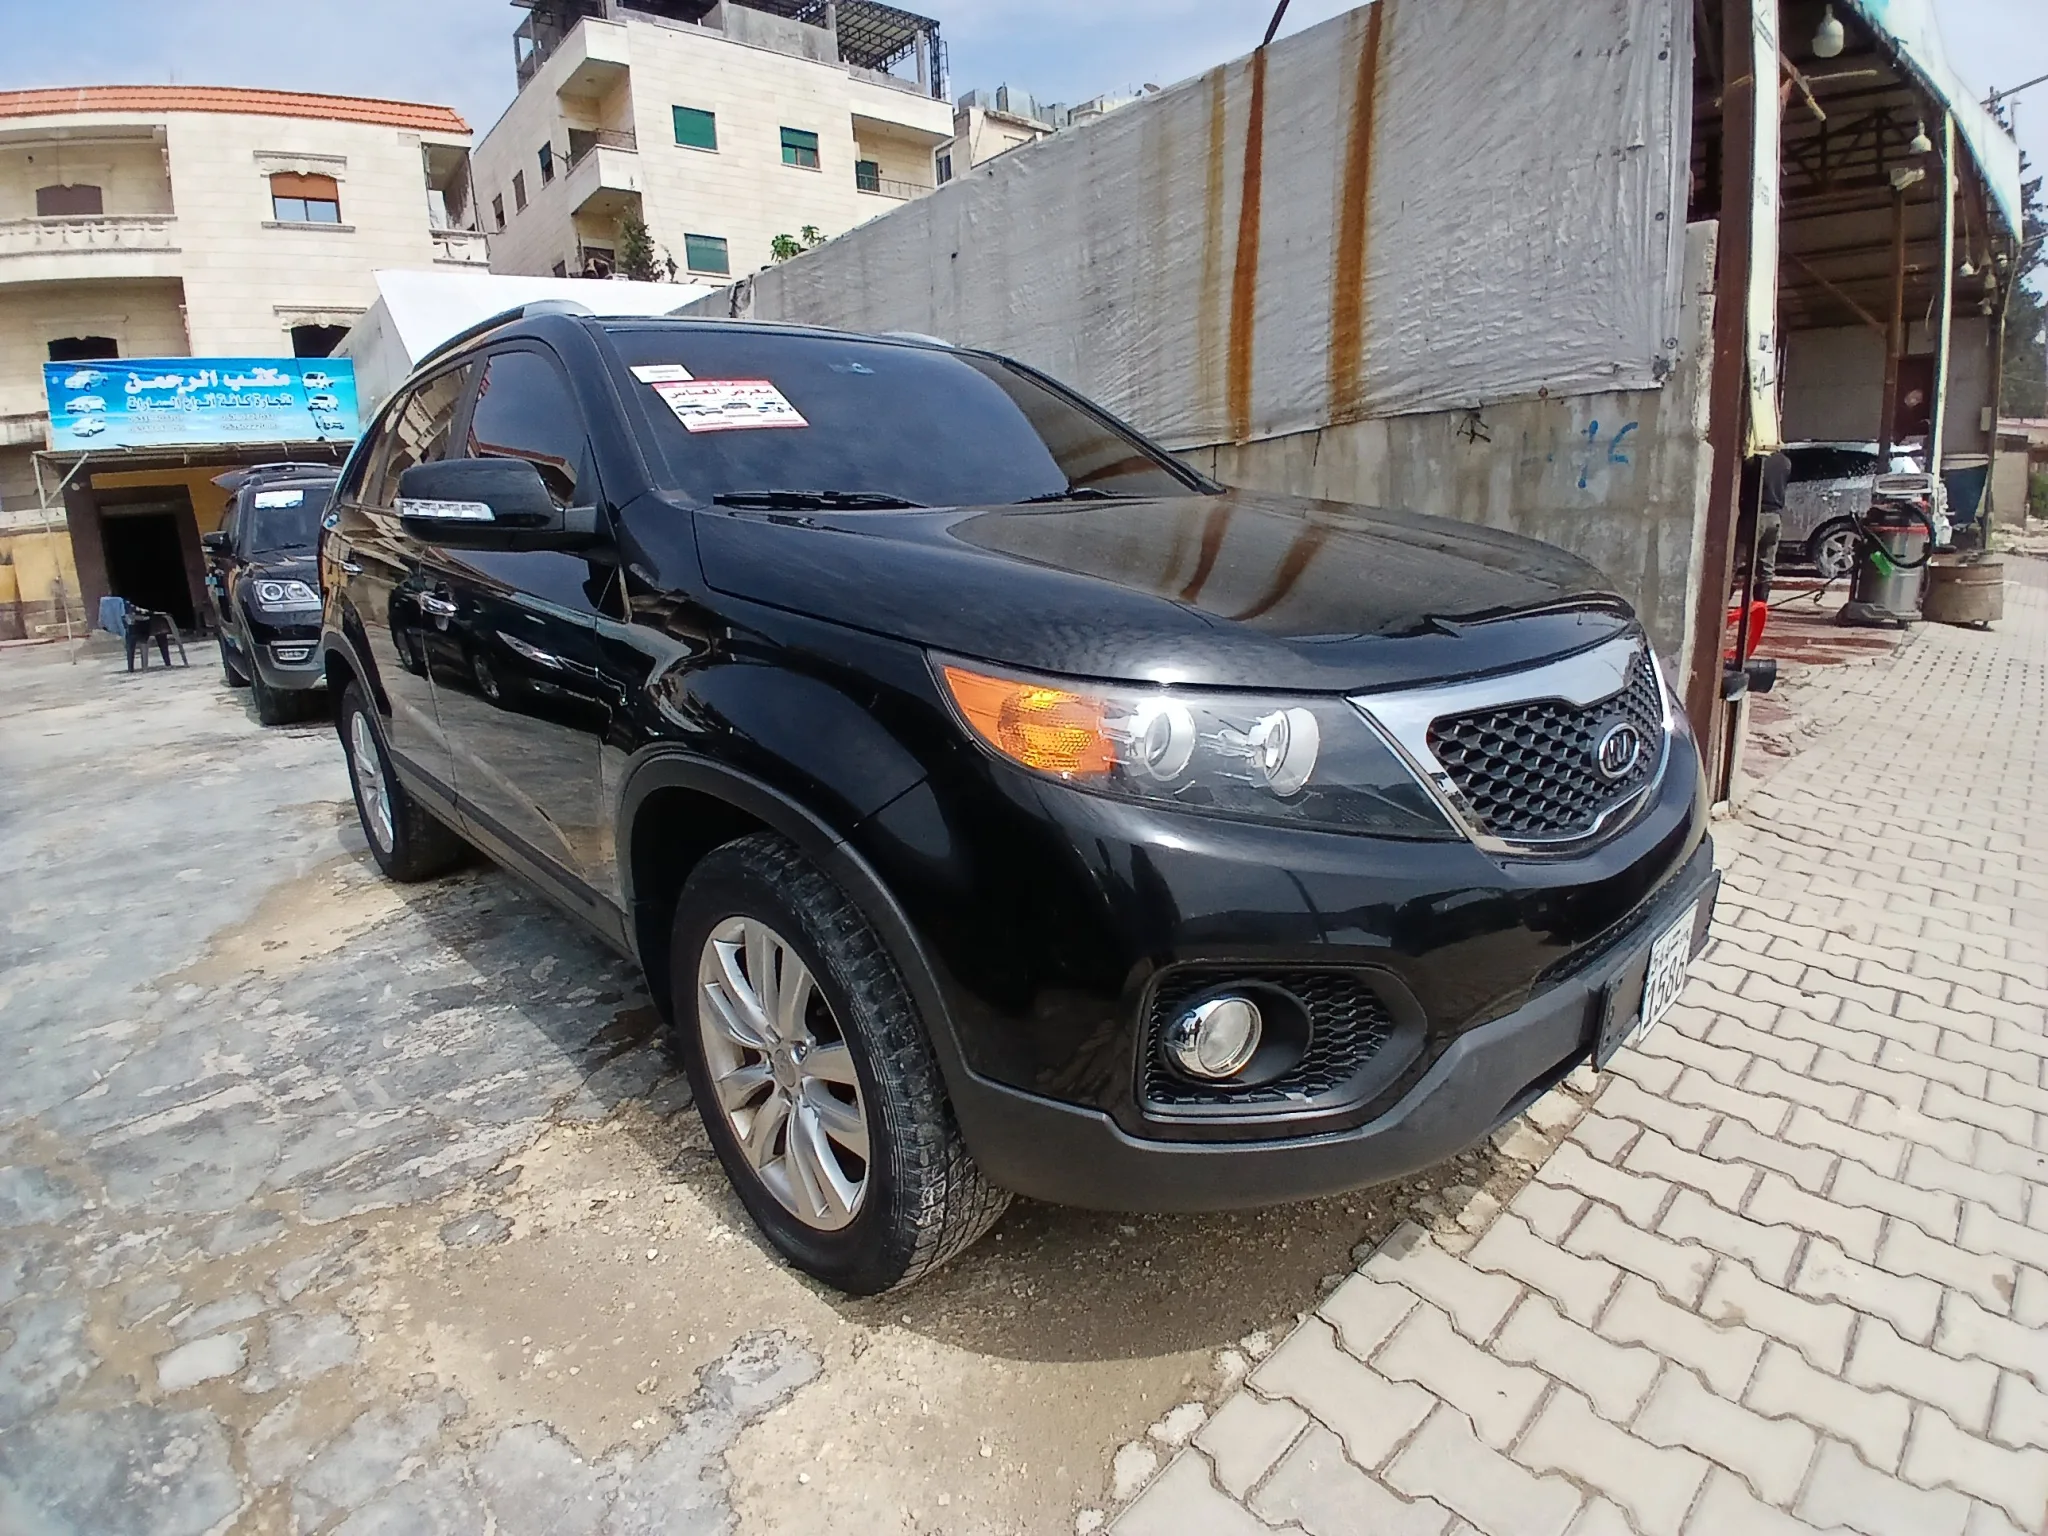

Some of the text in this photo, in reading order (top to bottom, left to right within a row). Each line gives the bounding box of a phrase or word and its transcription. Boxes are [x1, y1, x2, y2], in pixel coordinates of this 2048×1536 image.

[125, 367, 291, 394] مكتب الرحمن
[127, 393, 294, 412] لتجارة كافة أنواع السيارات
